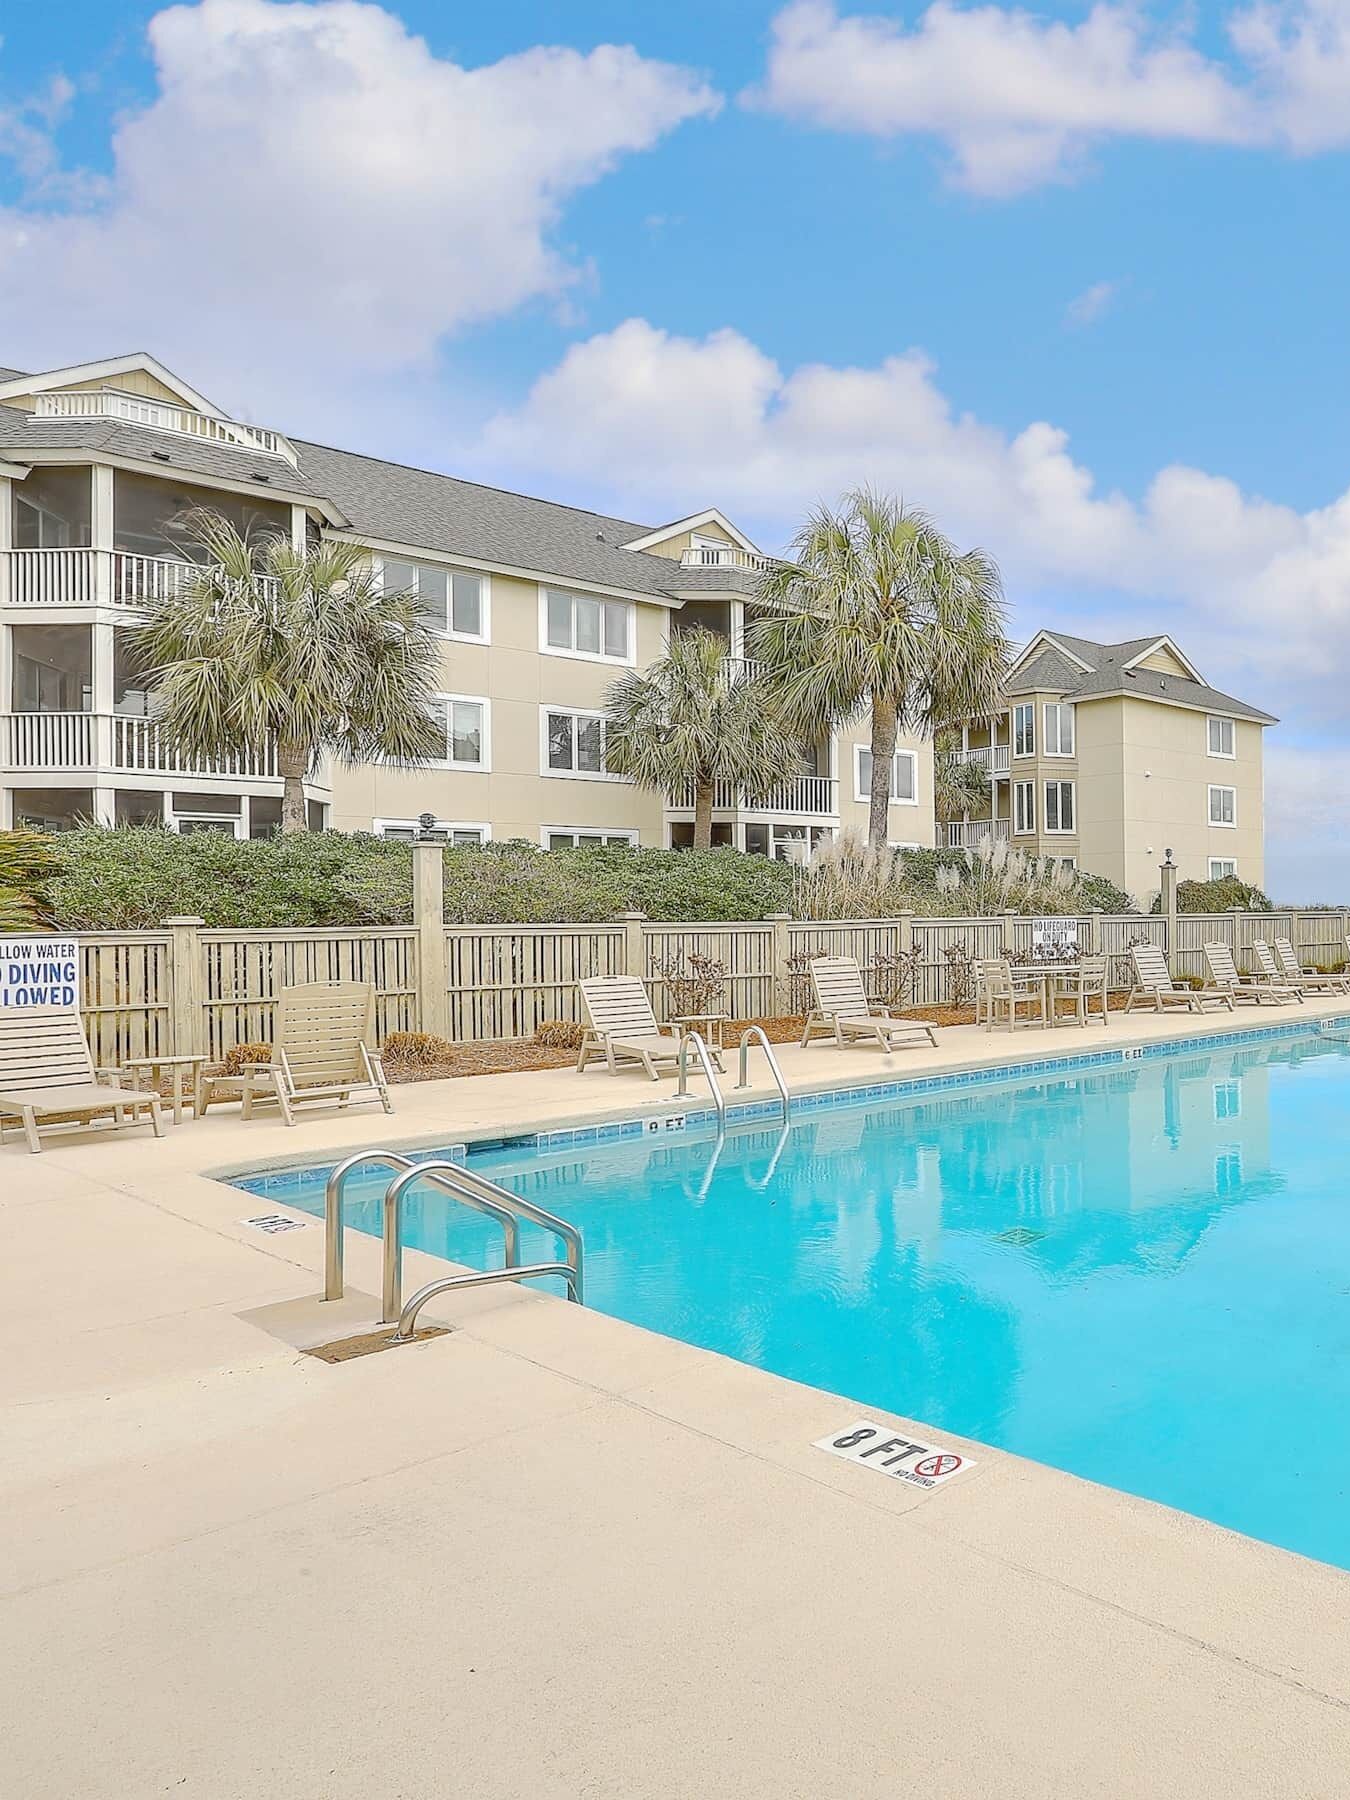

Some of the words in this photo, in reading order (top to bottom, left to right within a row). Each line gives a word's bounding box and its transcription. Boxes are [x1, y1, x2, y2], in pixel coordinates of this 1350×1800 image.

[1044, 920, 1076, 932] LIFEGUARD
[1043, 932, 1051, 942] ON
[1052, 931, 1068, 942] DUTY
[36, 944, 75, 959] WATER
[9, 962, 75, 985] DIVING
[832, 1429, 877, 1448] 8
[858, 1438, 928, 1467] FT
[892, 1469, 909, 1477] NO
[905, 1473, 936, 1487] DIVING
